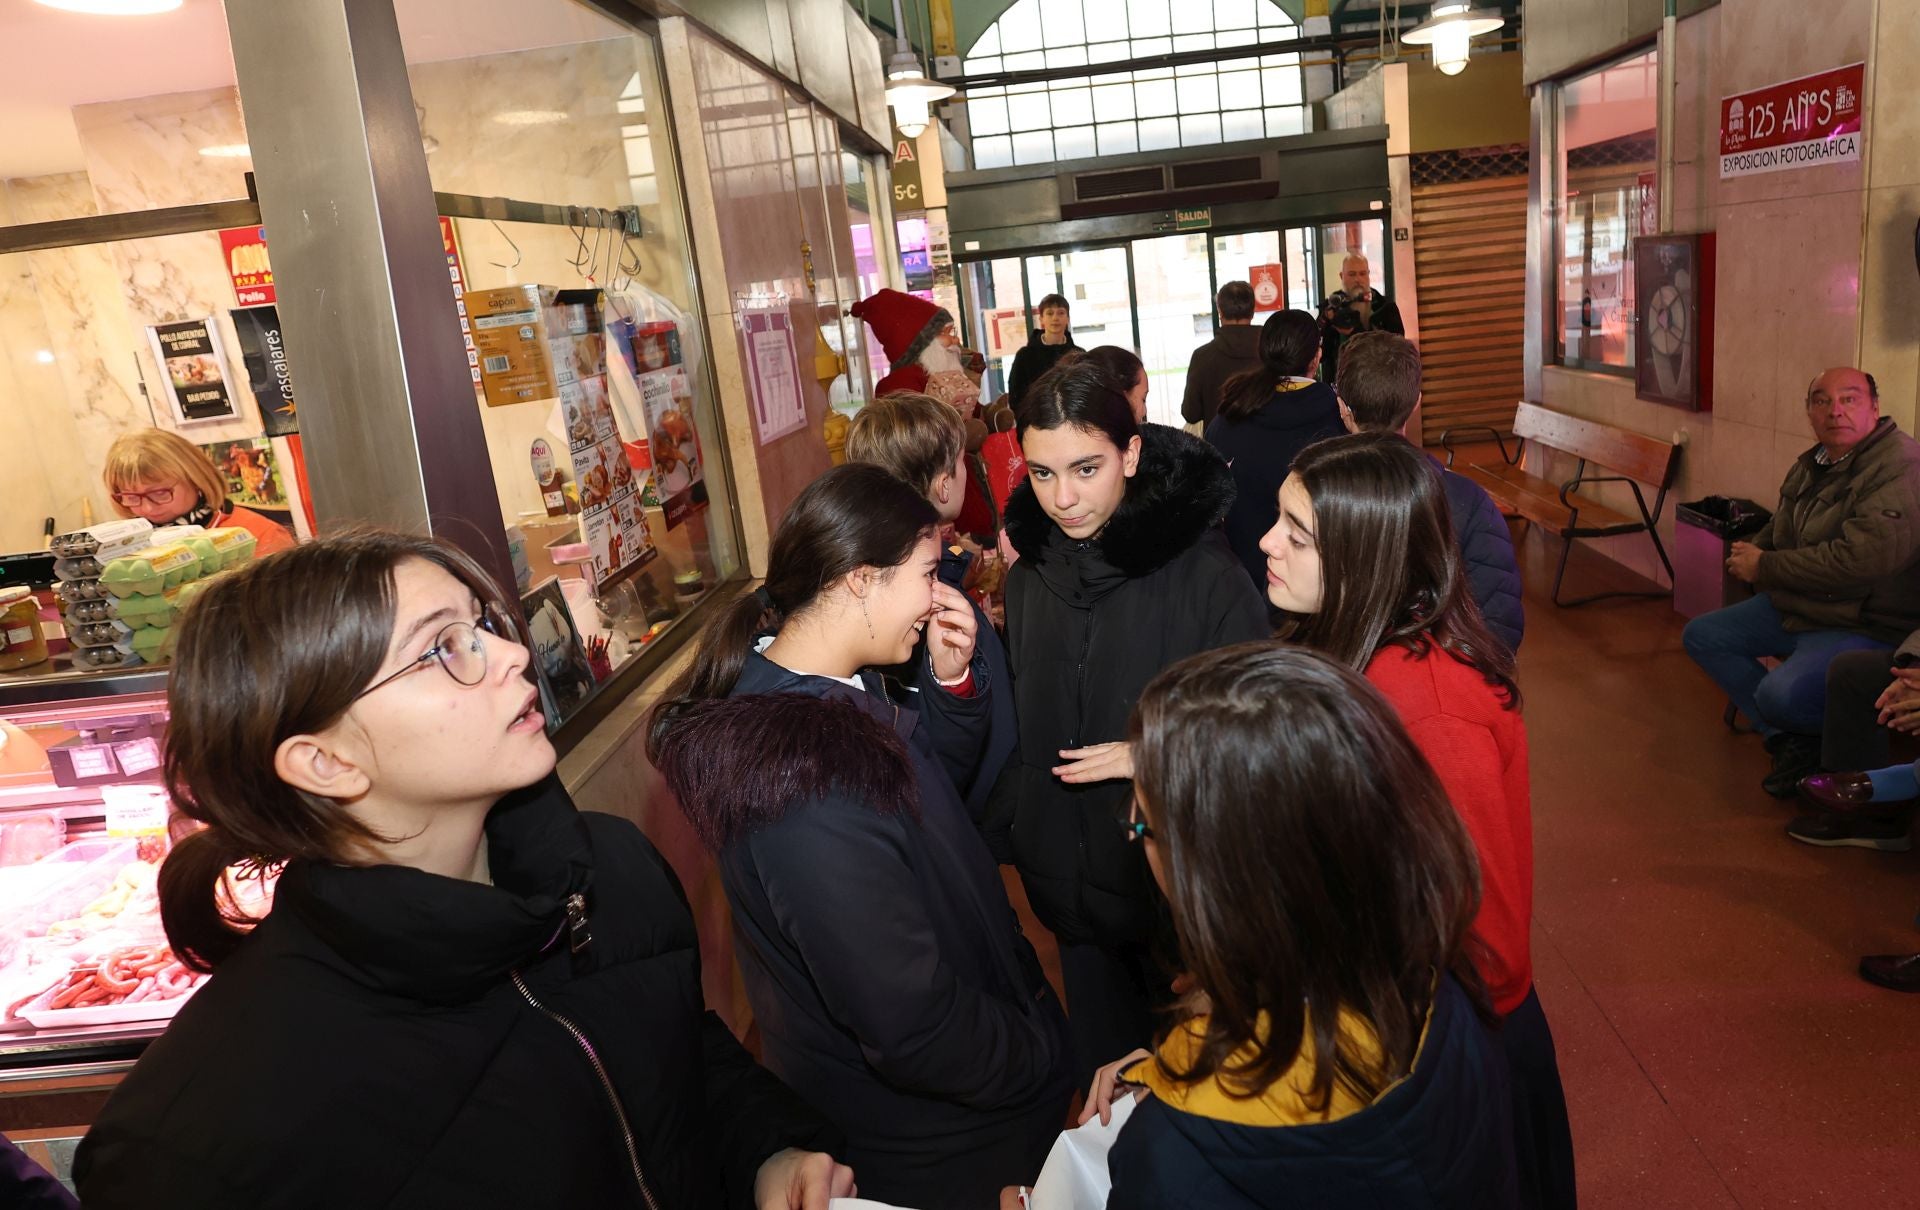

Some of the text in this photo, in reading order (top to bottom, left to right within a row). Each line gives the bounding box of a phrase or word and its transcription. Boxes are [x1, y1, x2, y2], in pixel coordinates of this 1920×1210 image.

[1748, 102, 1776, 139] 125
[894, 140, 915, 162] A
[1723, 138, 1856, 172] EXPOSICION FOTOGRAFICA
[1178, 210, 1209, 222] SALIDA
